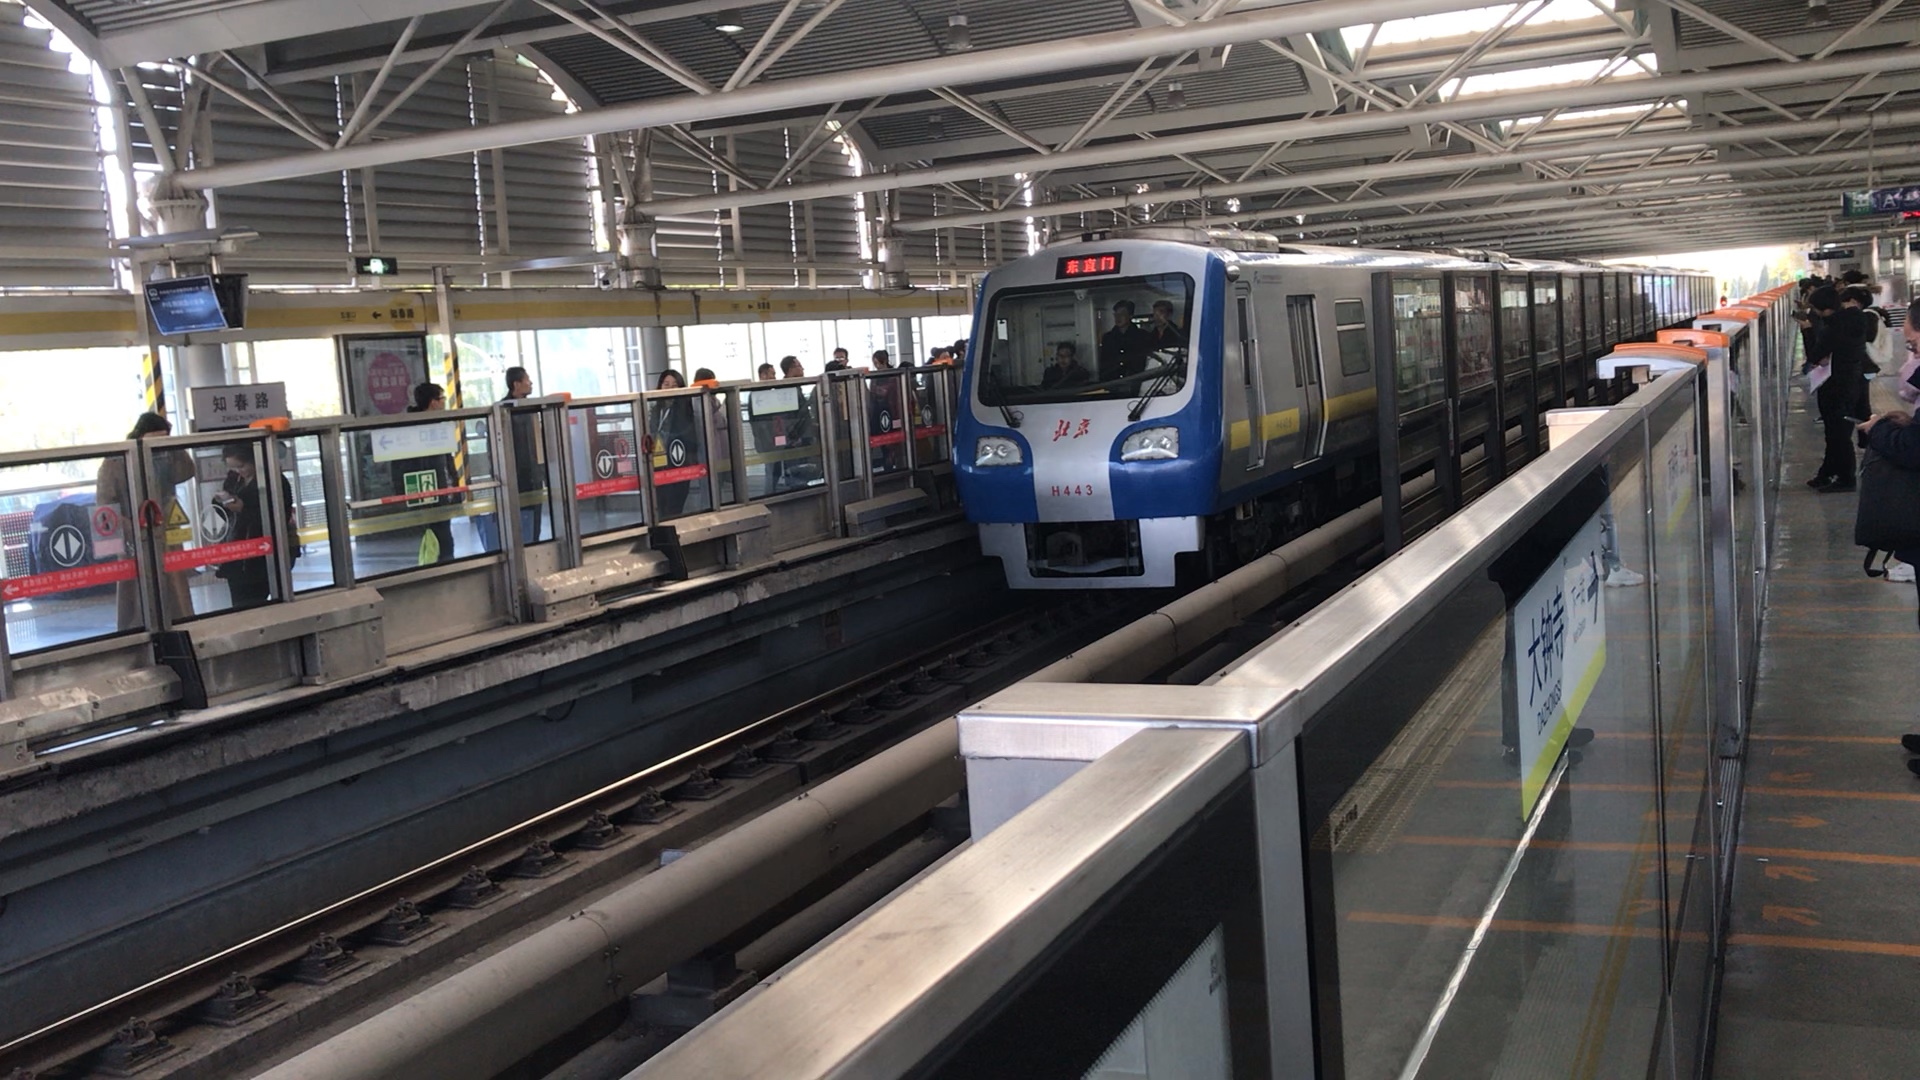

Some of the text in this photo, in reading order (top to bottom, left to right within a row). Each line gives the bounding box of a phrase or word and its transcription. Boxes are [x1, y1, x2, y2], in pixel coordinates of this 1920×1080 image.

[1065, 256, 1115, 274] 东直门
[213, 392, 269, 413] 知春路
[1053, 418, 1091, 442] 北京
[1051, 484, 1093, 497] H443
[1528, 585, 1564, 708] 大钟寺
